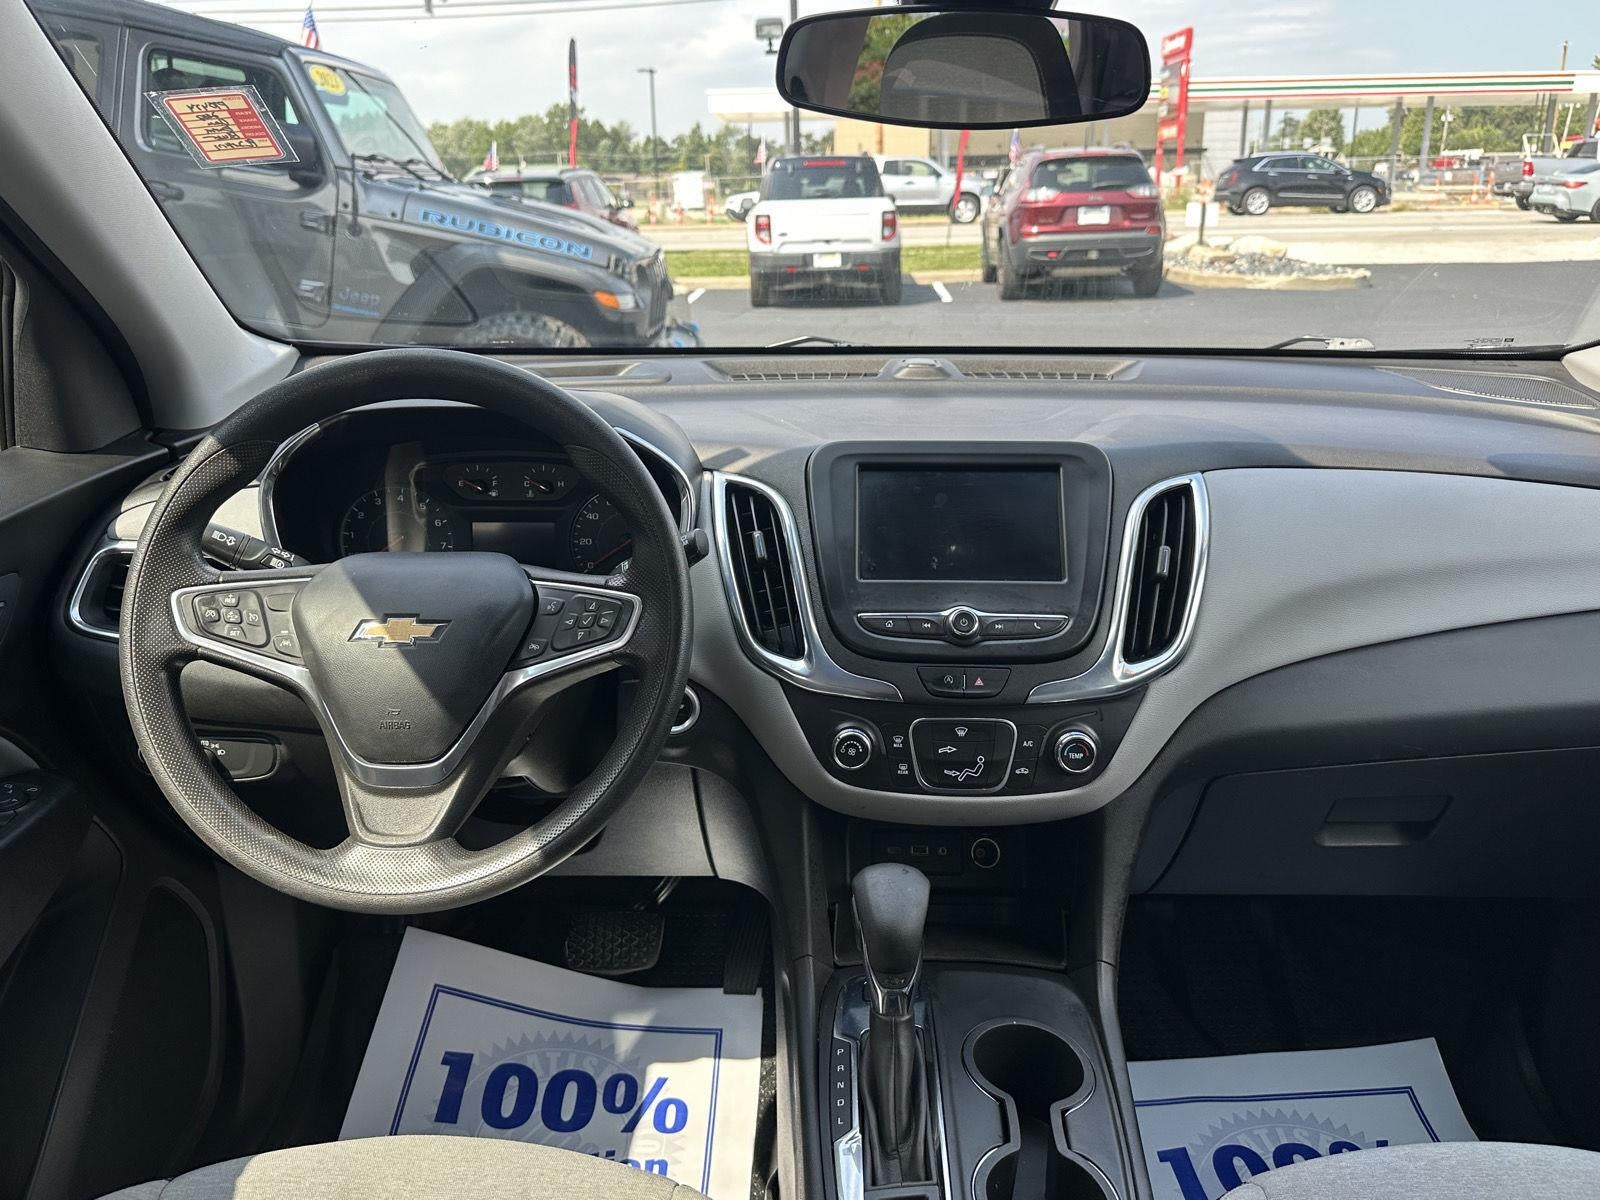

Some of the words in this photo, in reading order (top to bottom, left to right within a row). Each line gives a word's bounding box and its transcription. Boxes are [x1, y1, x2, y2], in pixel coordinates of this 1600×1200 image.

[420, 208, 592, 259] RUBICON
[375, 498, 382, 506] 3
[419, 502, 426, 510] 5
[358, 511, 364, 519] 2
[586, 512, 599, 520] 40
[434, 519, 441, 527] 6
[579, 538, 592, 546] 20
[380, 720, 411, 730] AIRBAG
[1023, 740, 1034, 748] A/C
[1068, 752, 1084, 760] TEMP
[837, 1048, 844, 1056] P
[837, 1064, 844, 1072] R
[837, 1081, 845, 1089] N
[434, 1051, 689, 1134] 100%
[836, 1098, 845, 1107] D
[837, 1117, 844, 1125] L
